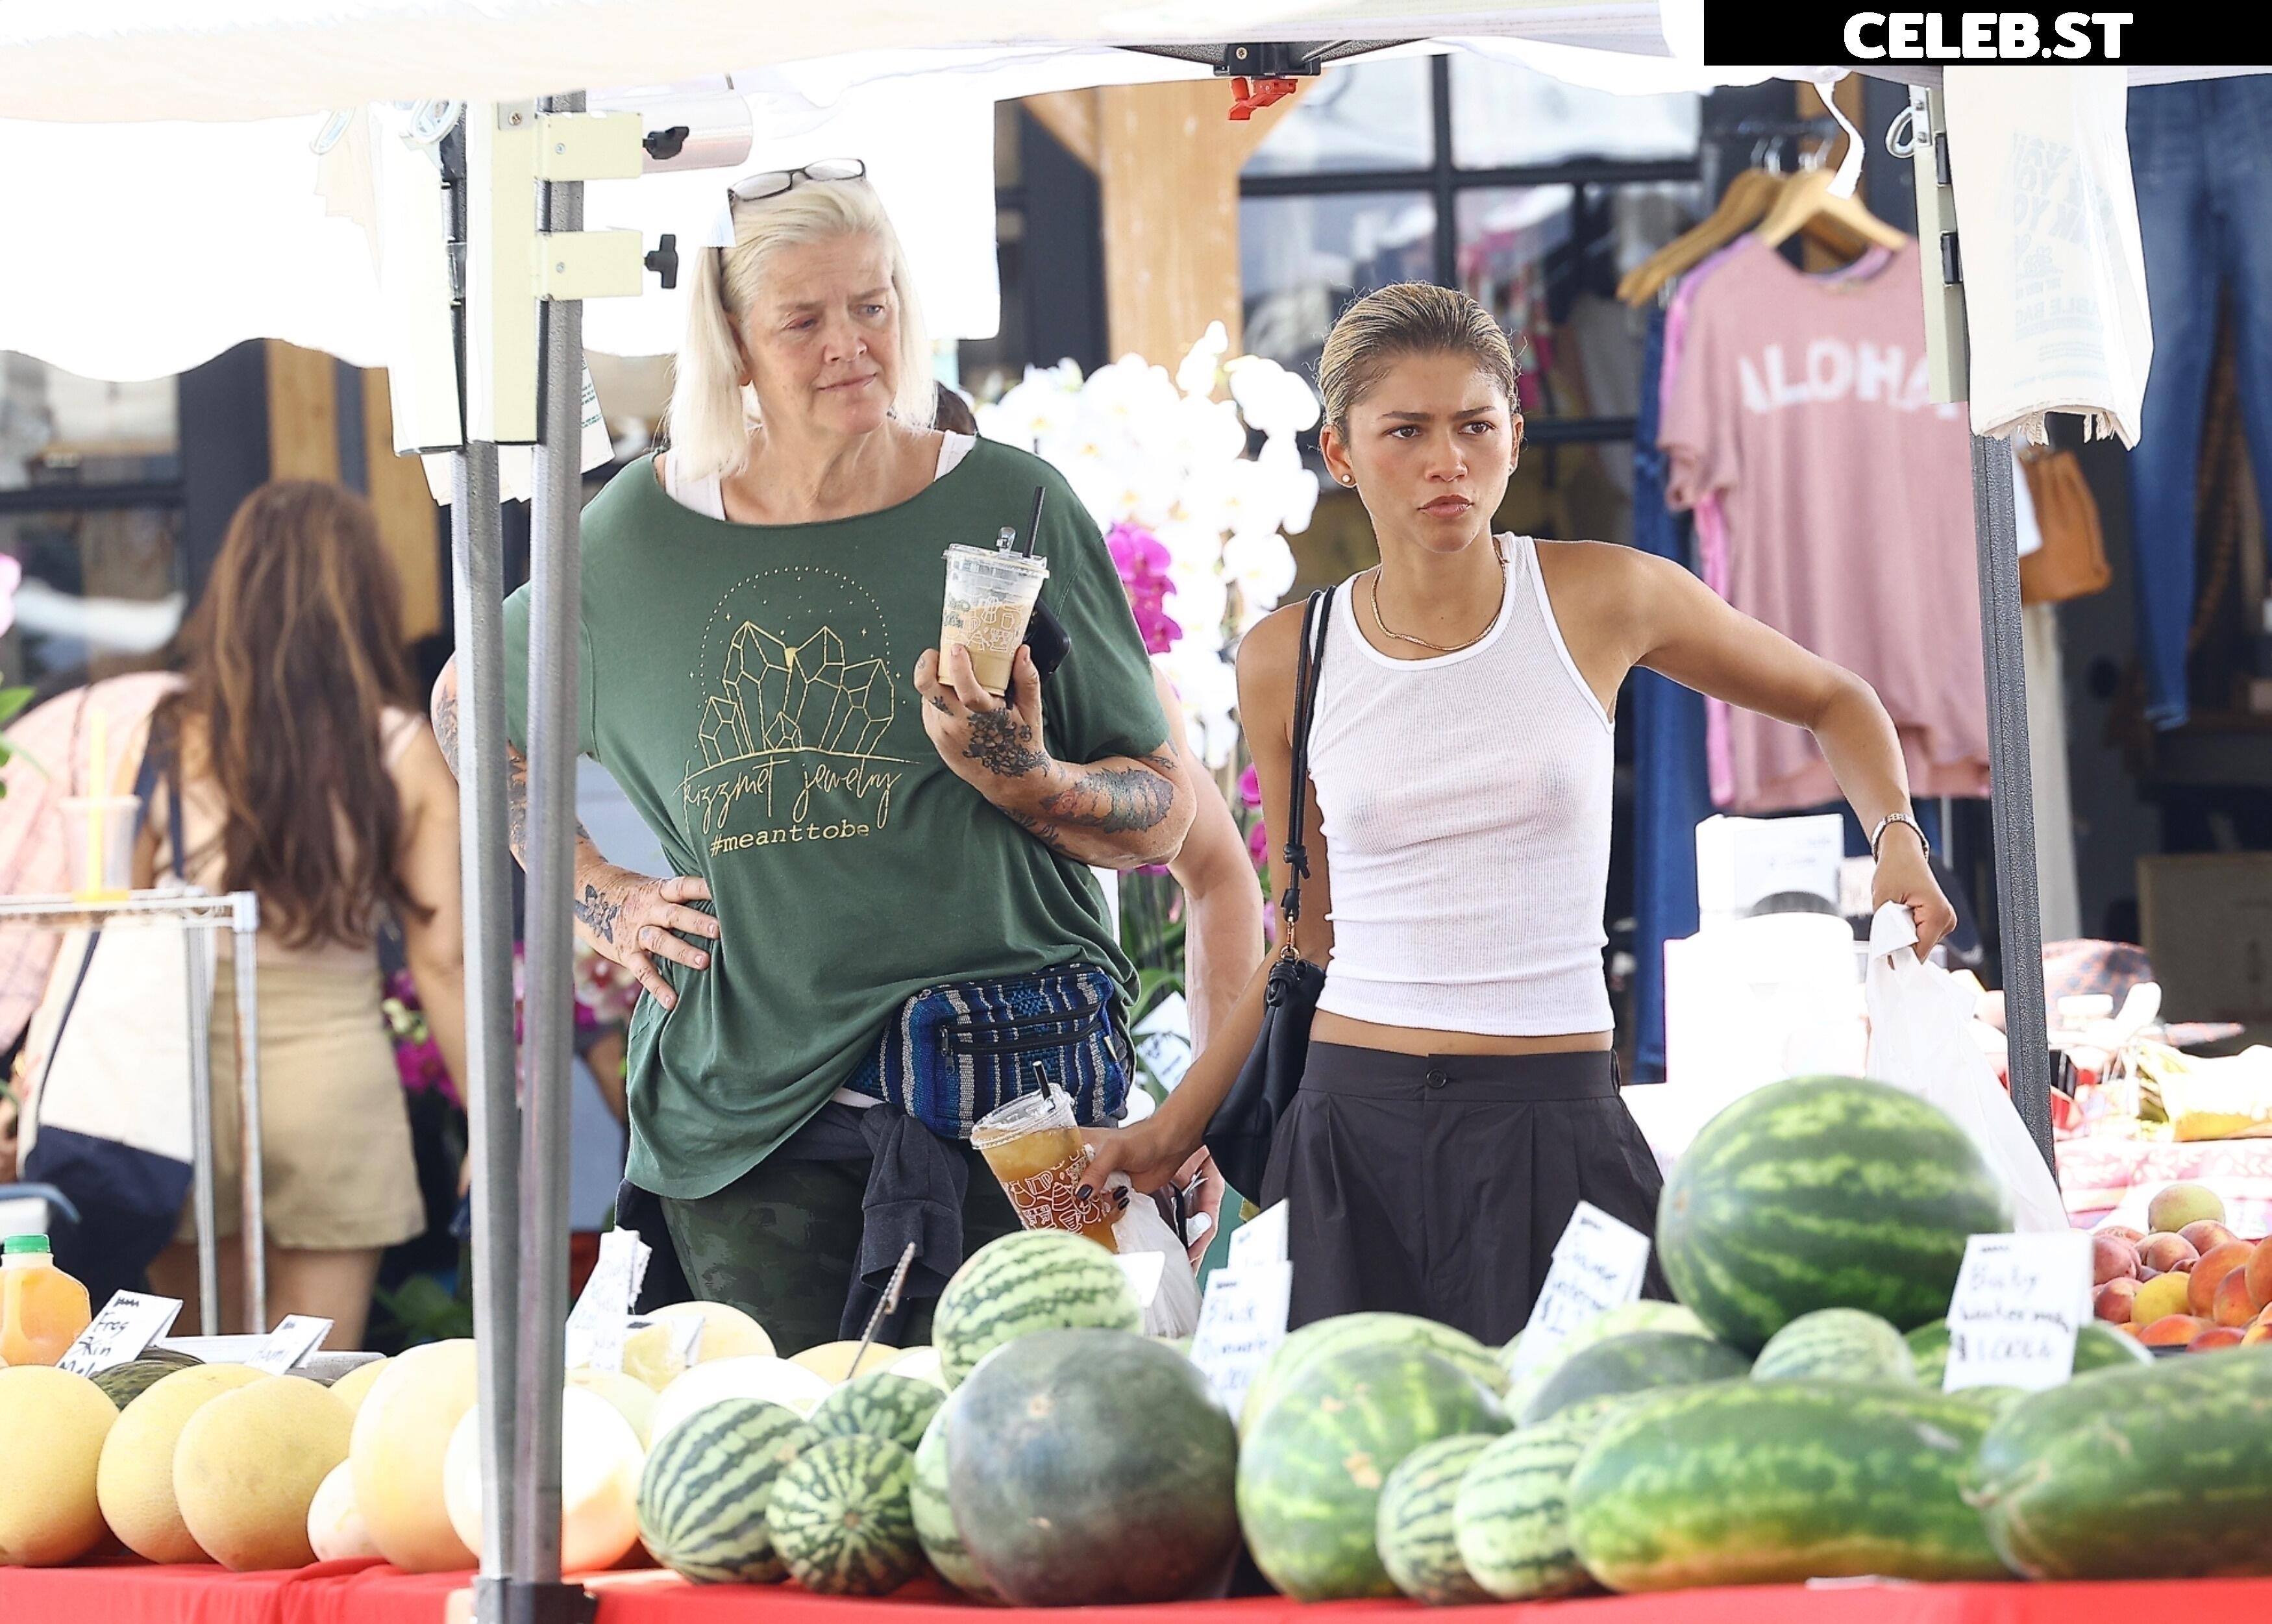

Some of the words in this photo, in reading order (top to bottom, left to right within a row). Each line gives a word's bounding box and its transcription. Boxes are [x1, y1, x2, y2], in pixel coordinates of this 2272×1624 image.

[793, 757, 903, 830] jewelry
[710, 819, 870, 857] #meanttobe
[93, 1311, 129, 1339] Frog
